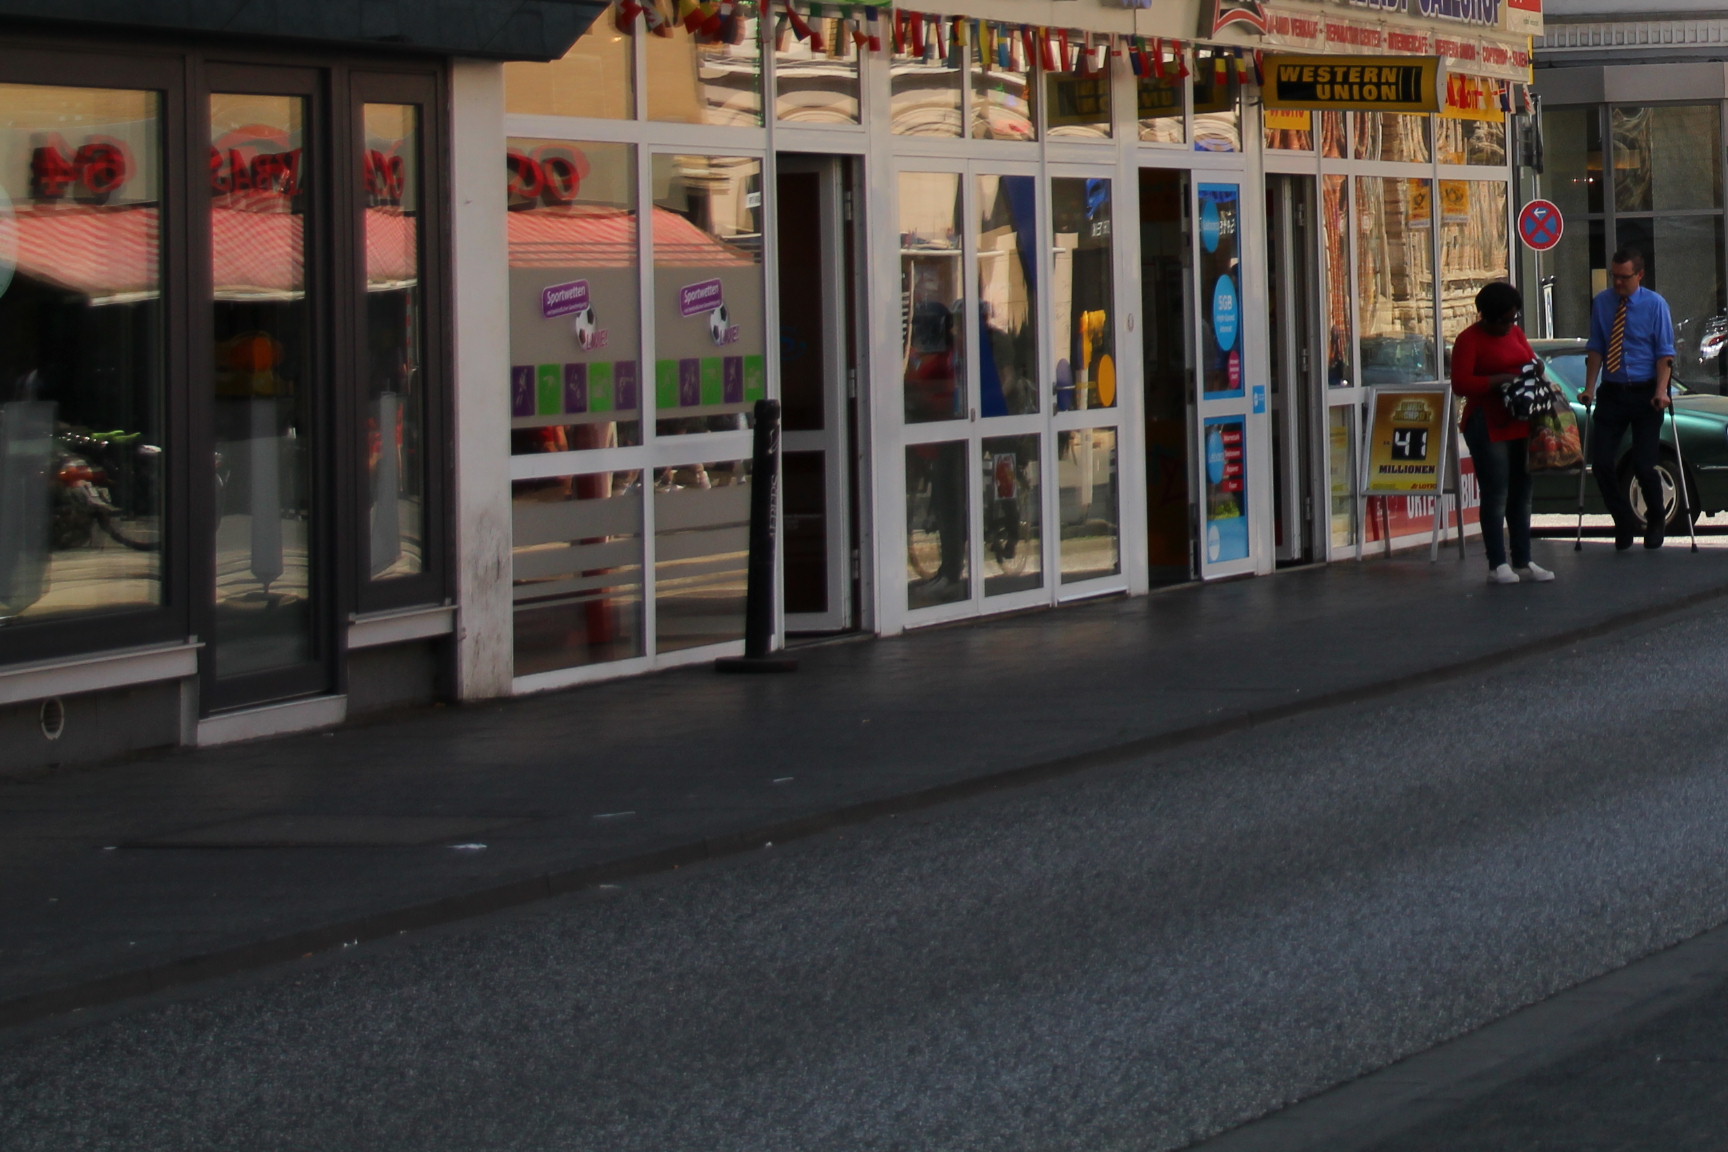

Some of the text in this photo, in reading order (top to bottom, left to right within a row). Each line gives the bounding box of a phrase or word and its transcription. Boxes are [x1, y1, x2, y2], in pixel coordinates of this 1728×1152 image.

[1279, 66, 1398, 83] WESTERN
[1316, 85, 1398, 101] UNION
[547, 286, 586, 307] Sportwetten
[684, 285, 719, 305] Sportwetten
[1395, 431, 1427, 457] 41
[1379, 464, 1436, 475] MILLIONEN
